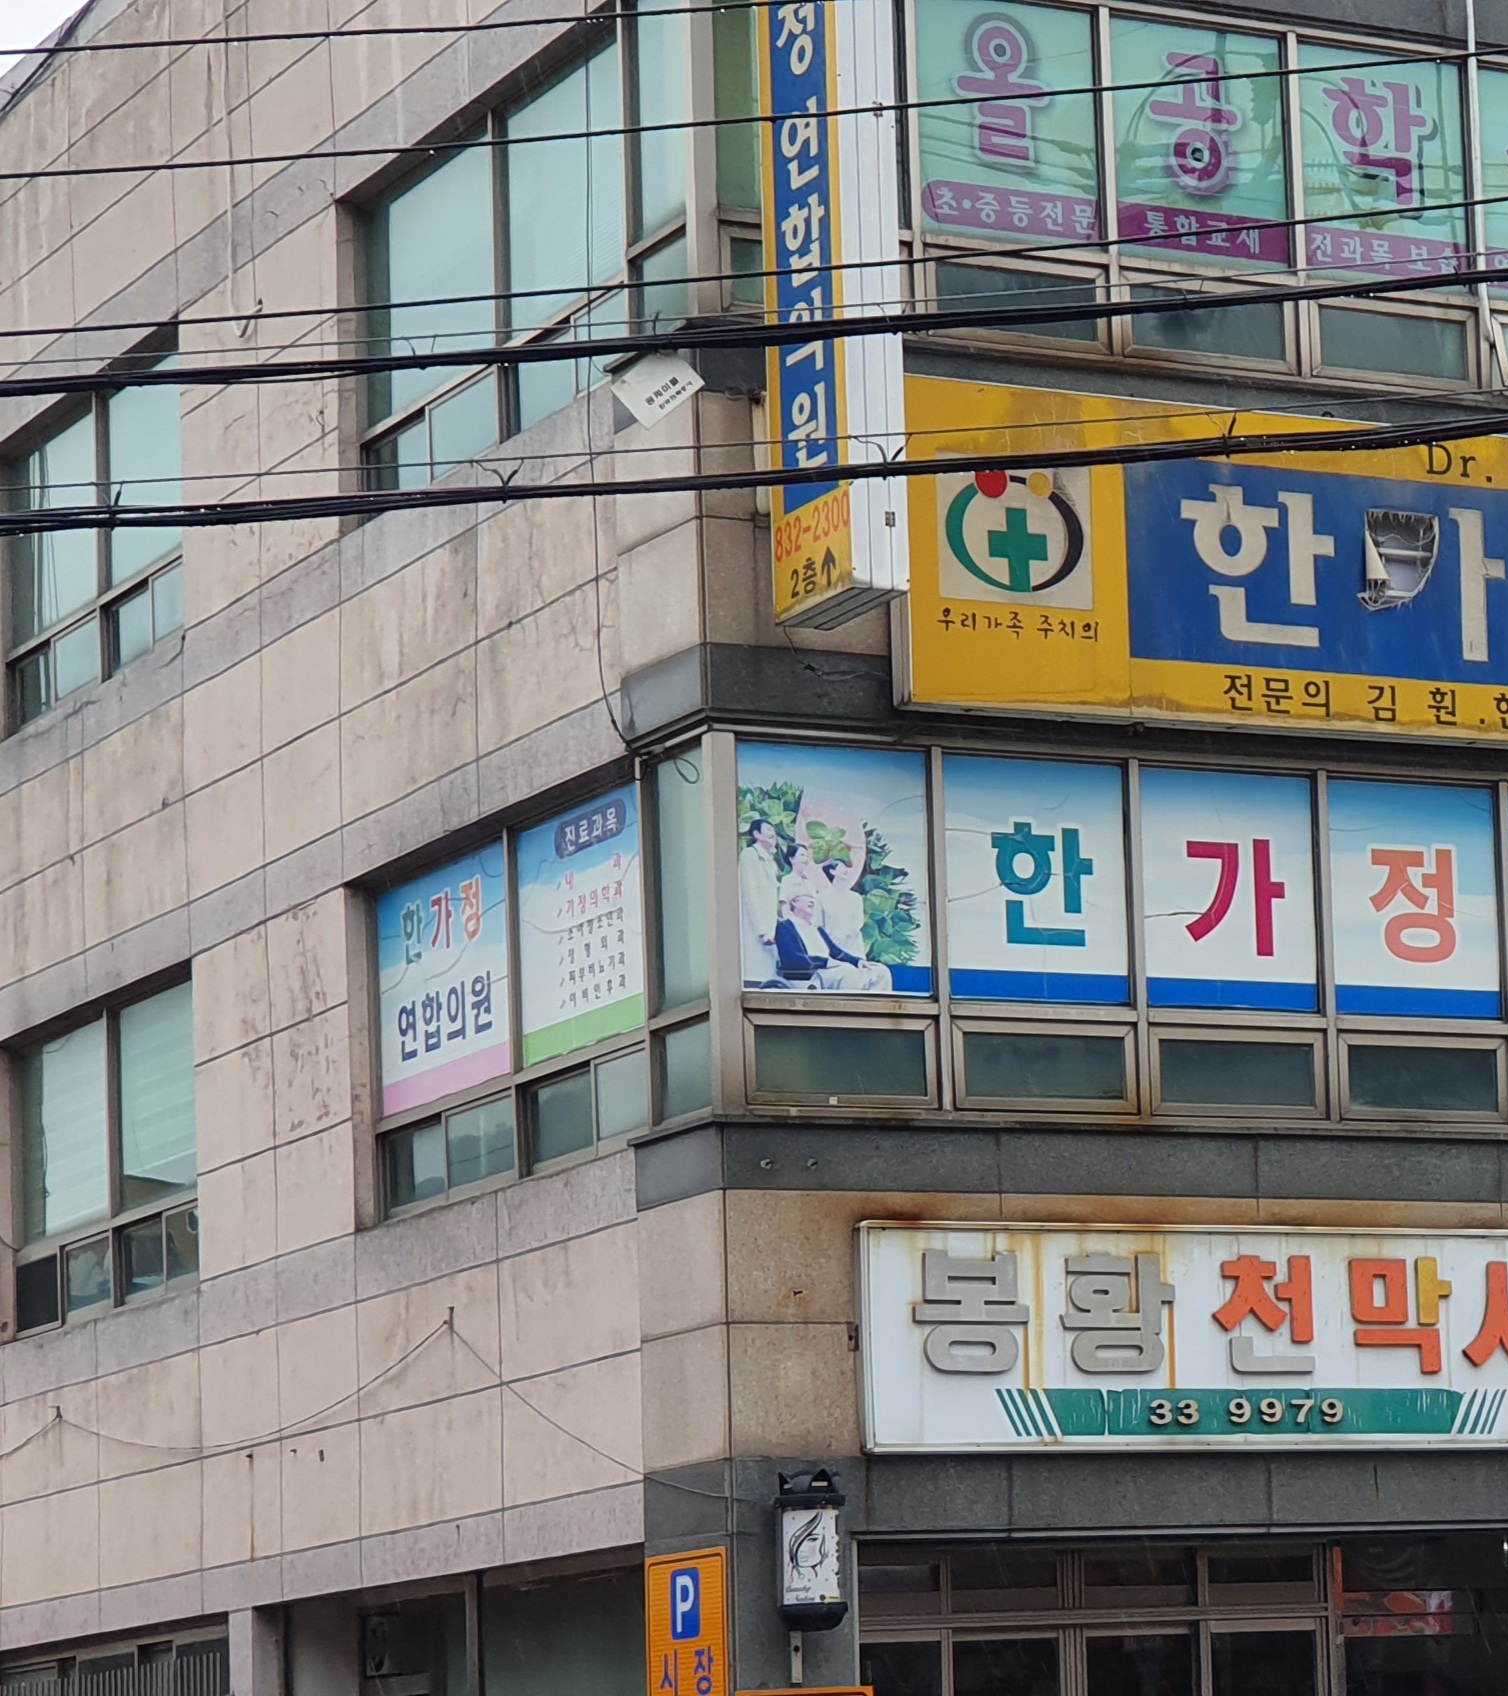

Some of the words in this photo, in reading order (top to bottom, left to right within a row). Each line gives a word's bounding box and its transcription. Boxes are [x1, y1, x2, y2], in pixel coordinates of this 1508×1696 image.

[1310, 232, 1393, 270] 전과목
[1426, 444, 1494, 483] Dr.
[775, 490, 850, 564] 832-2300
[790, 557, 817, 600] 2층
[937, 607, 1025, 640] 우리가족
[1036, 614, 1100, 643] 주치의
[1223, 673, 1332, 718] 전문의
[564, 807, 618, 850] 진료과목
[402, 874, 483, 966] 한가정
[398, 970, 493, 1062] 연합의원
[1149, 1398, 1200, 1426] 33
[1229, 1396, 1345, 1425] 9979
[676, 1574, 695, 1633] P
